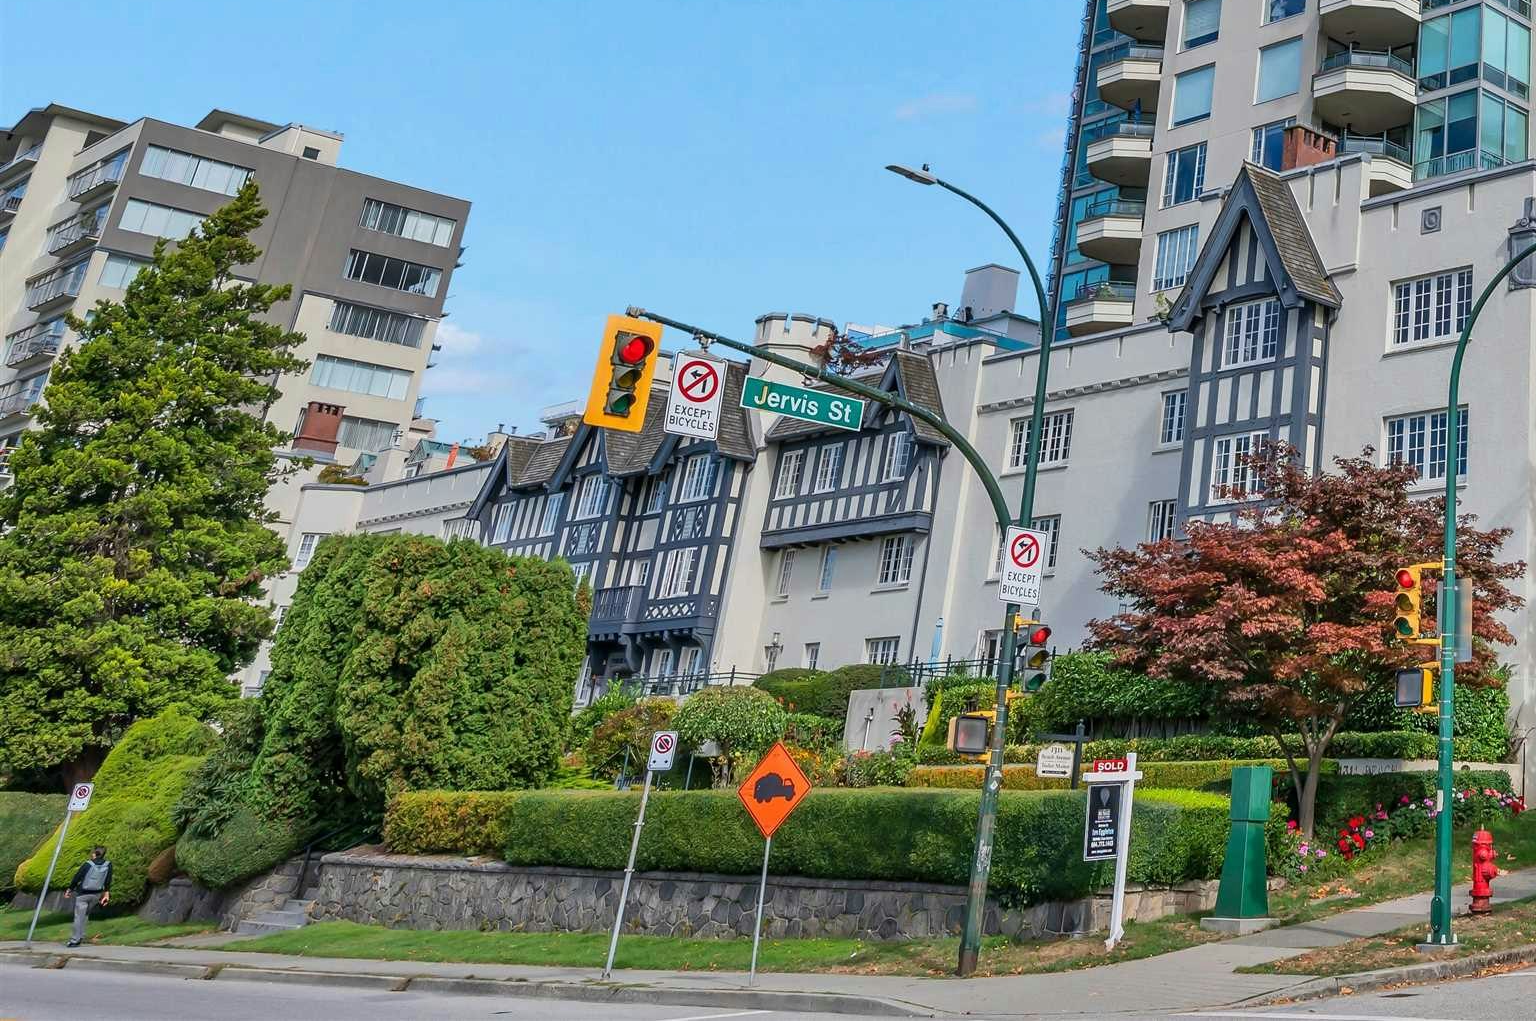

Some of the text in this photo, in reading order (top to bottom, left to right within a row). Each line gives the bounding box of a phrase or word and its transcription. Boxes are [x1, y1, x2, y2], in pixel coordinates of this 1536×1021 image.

[674, 404, 713, 419] EXCEPT
[754, 386, 851, 423] Jervis St
[669, 415, 714, 431] BICYCLES
[1008, 571, 1036, 584] EXCEPT
[1002, 584, 1038, 598] BICYCLES
[1097, 761, 1124, 771] SOLD
